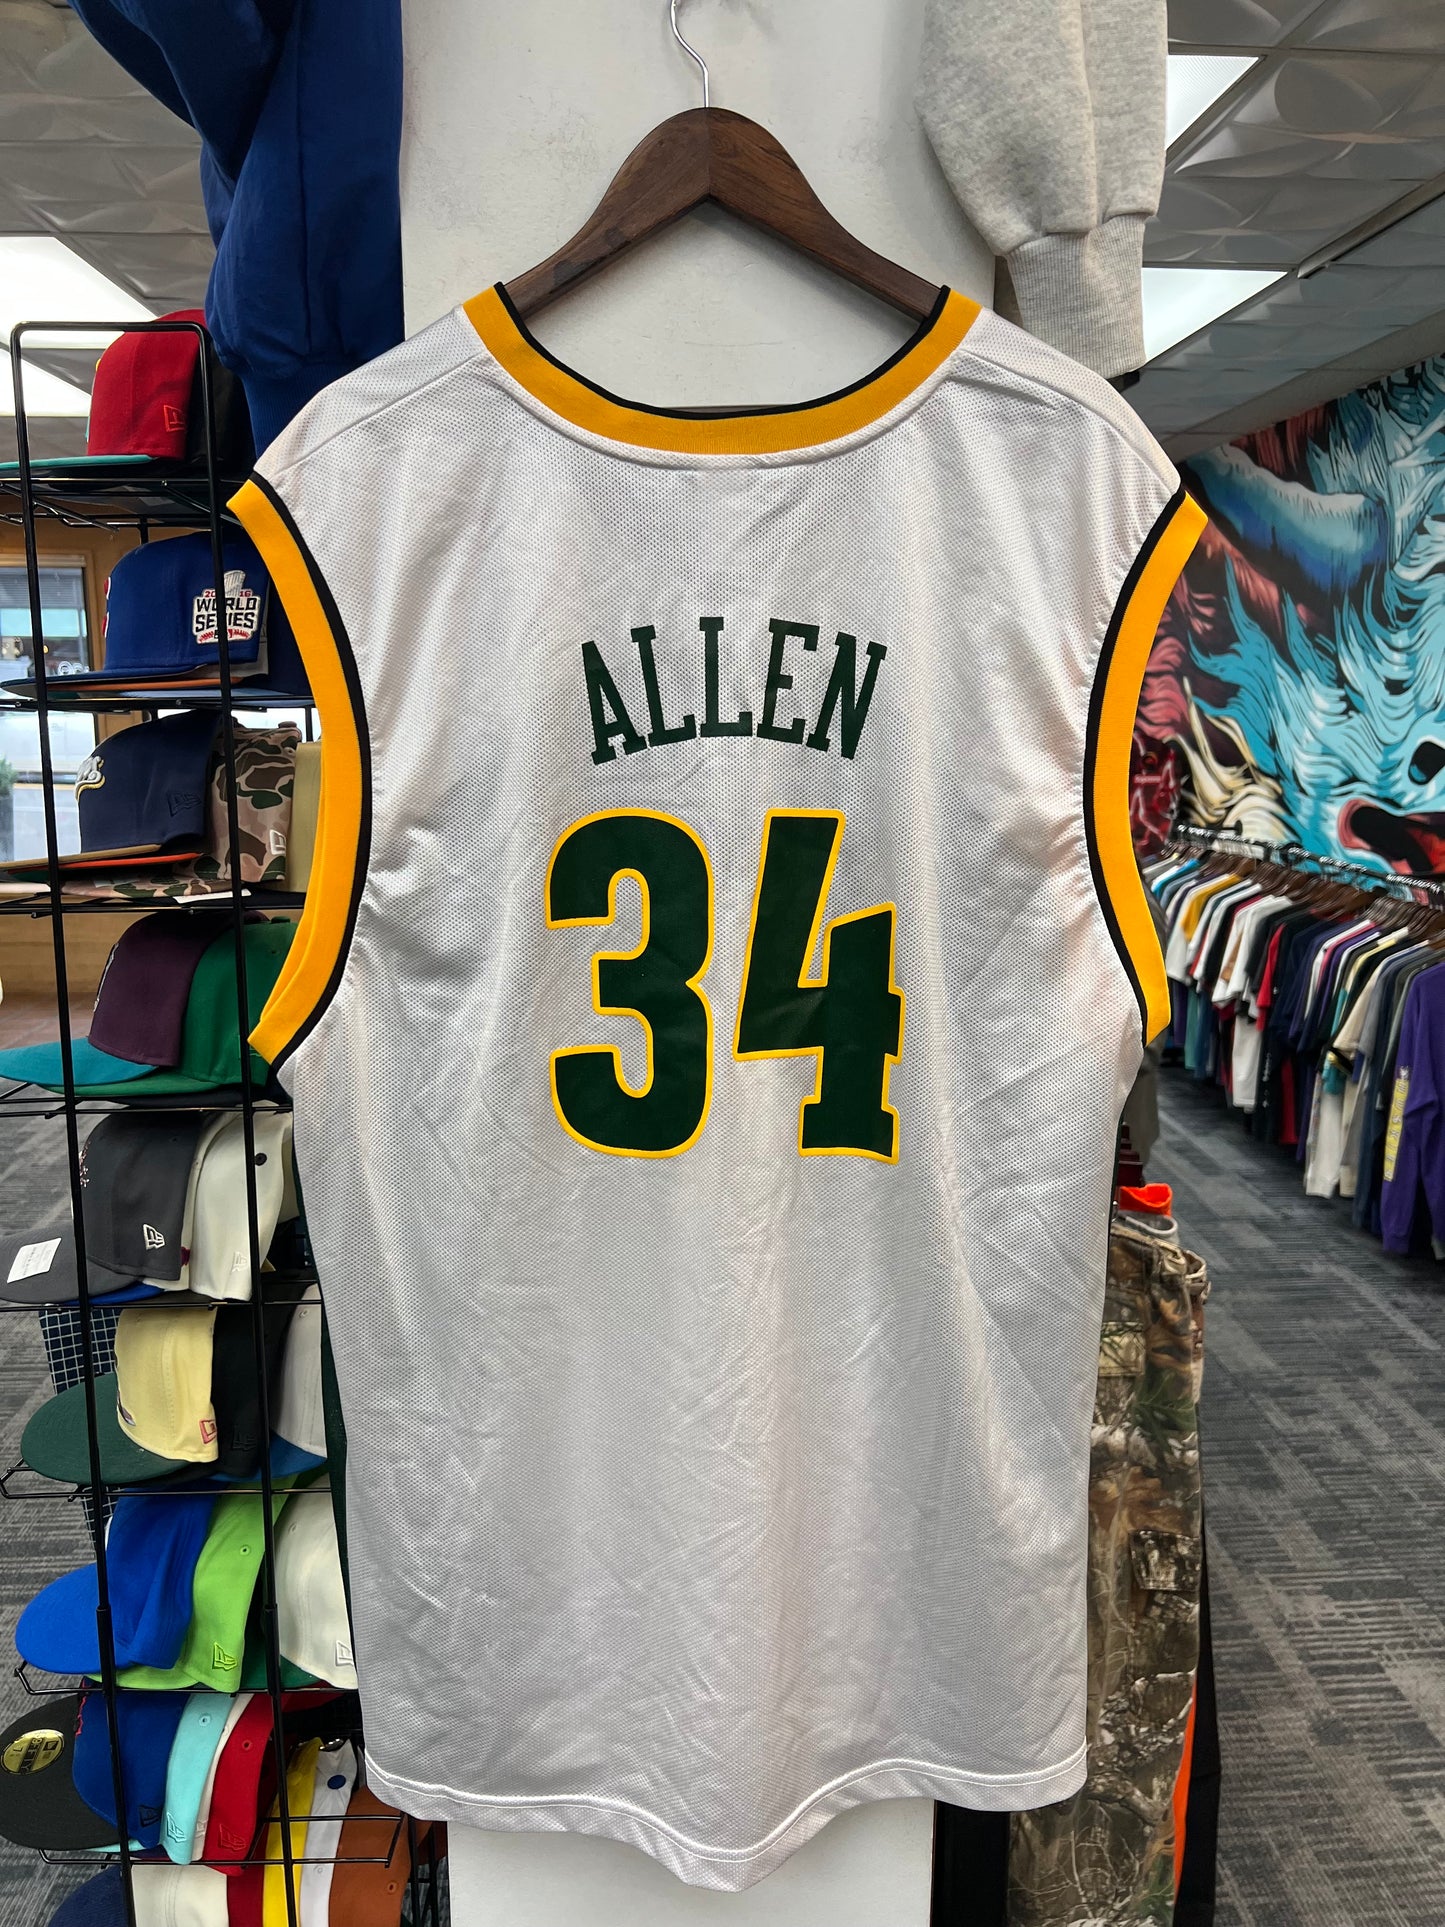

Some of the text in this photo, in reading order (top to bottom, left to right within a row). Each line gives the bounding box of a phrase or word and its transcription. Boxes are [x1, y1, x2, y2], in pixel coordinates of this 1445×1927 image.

[195, 612, 255, 633] SEIES
[582, 616, 888, 765] ALLEN
[545, 807, 906, 1165] 34
